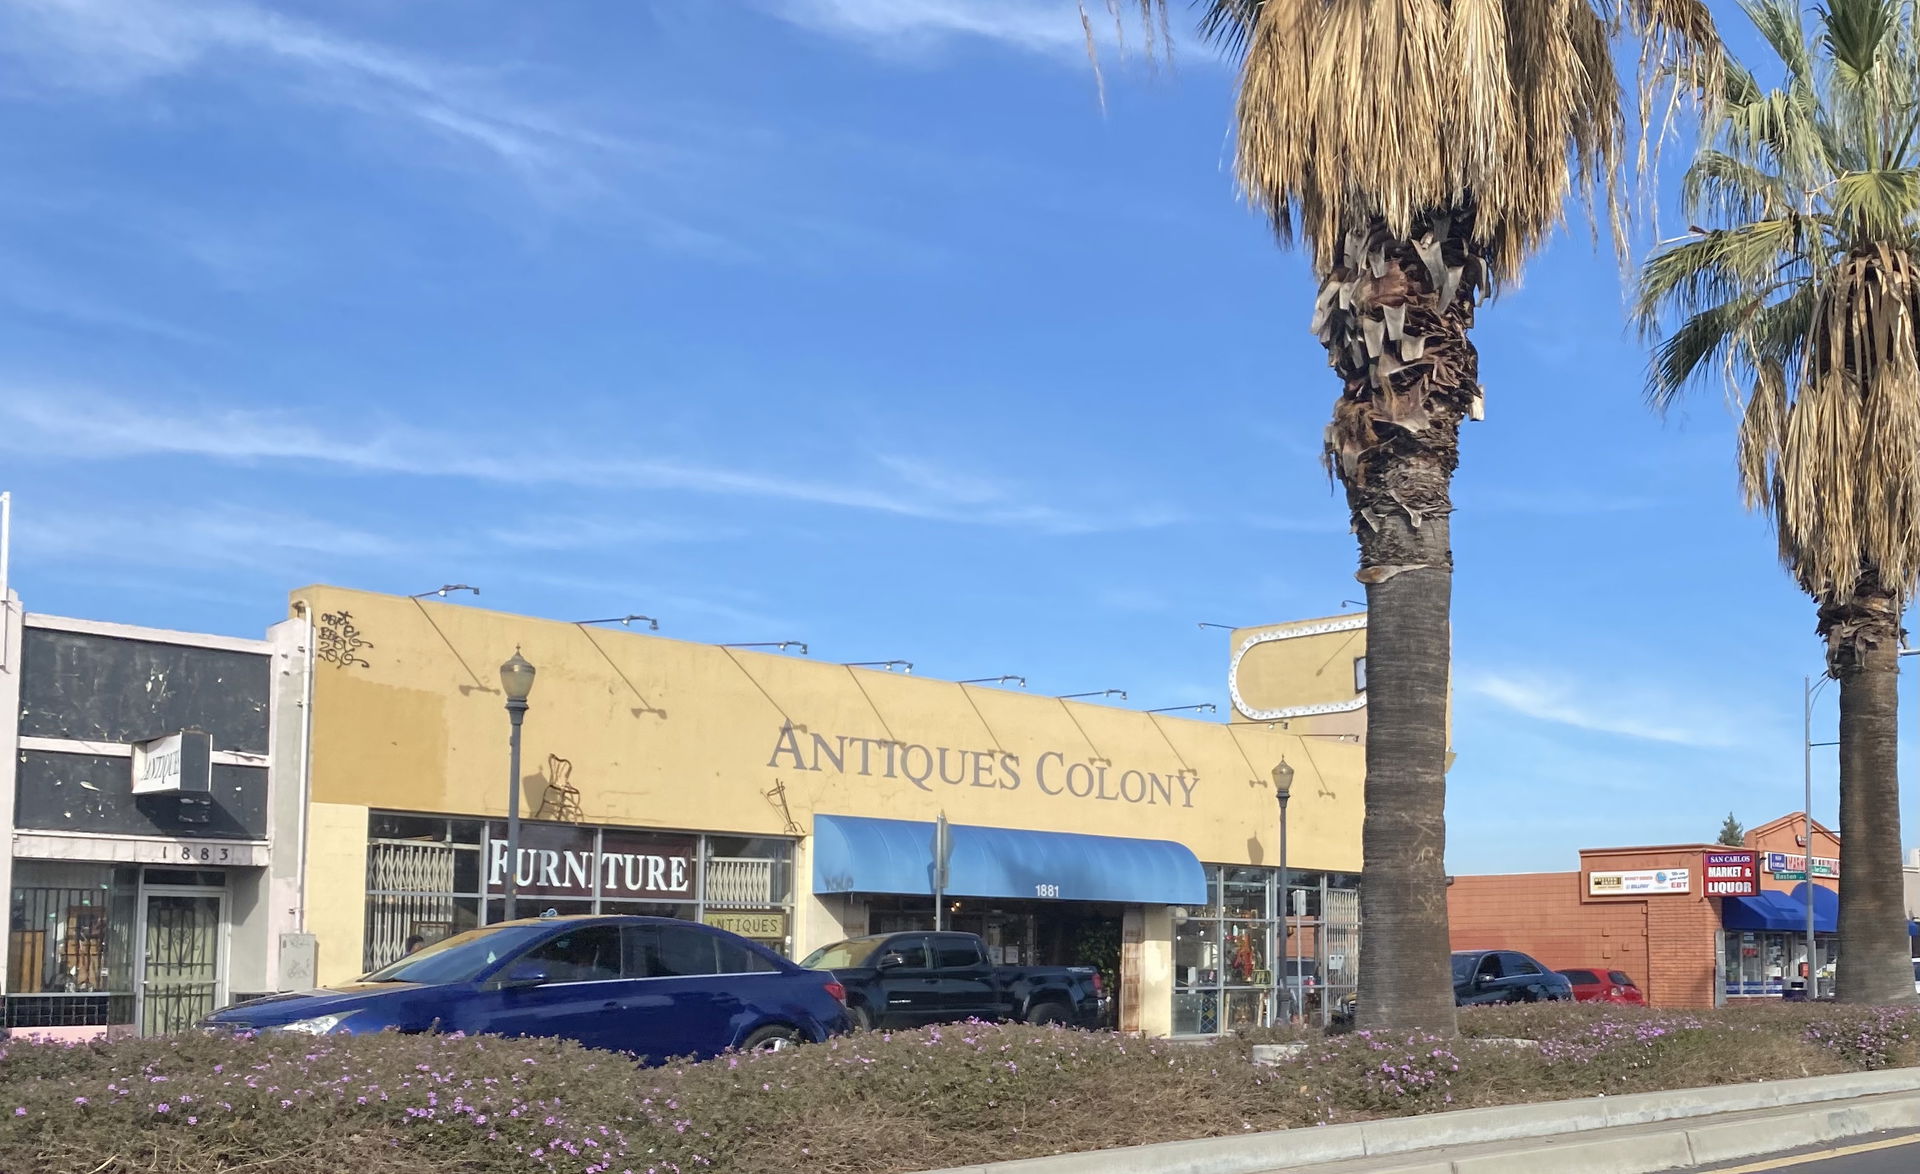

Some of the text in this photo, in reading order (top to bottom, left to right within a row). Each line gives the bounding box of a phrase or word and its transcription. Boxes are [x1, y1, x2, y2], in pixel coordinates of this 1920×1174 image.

[767, 718, 1200, 808] ANTIQUES COLONY
[162, 846, 229, 860] 1883
[1710, 855, 1751, 863] SAN CARLOS
[1708, 866, 1752, 877] MARKET &
[1035, 884, 1059, 897] 1881
[1708, 882, 1752, 894] LIQUOR
